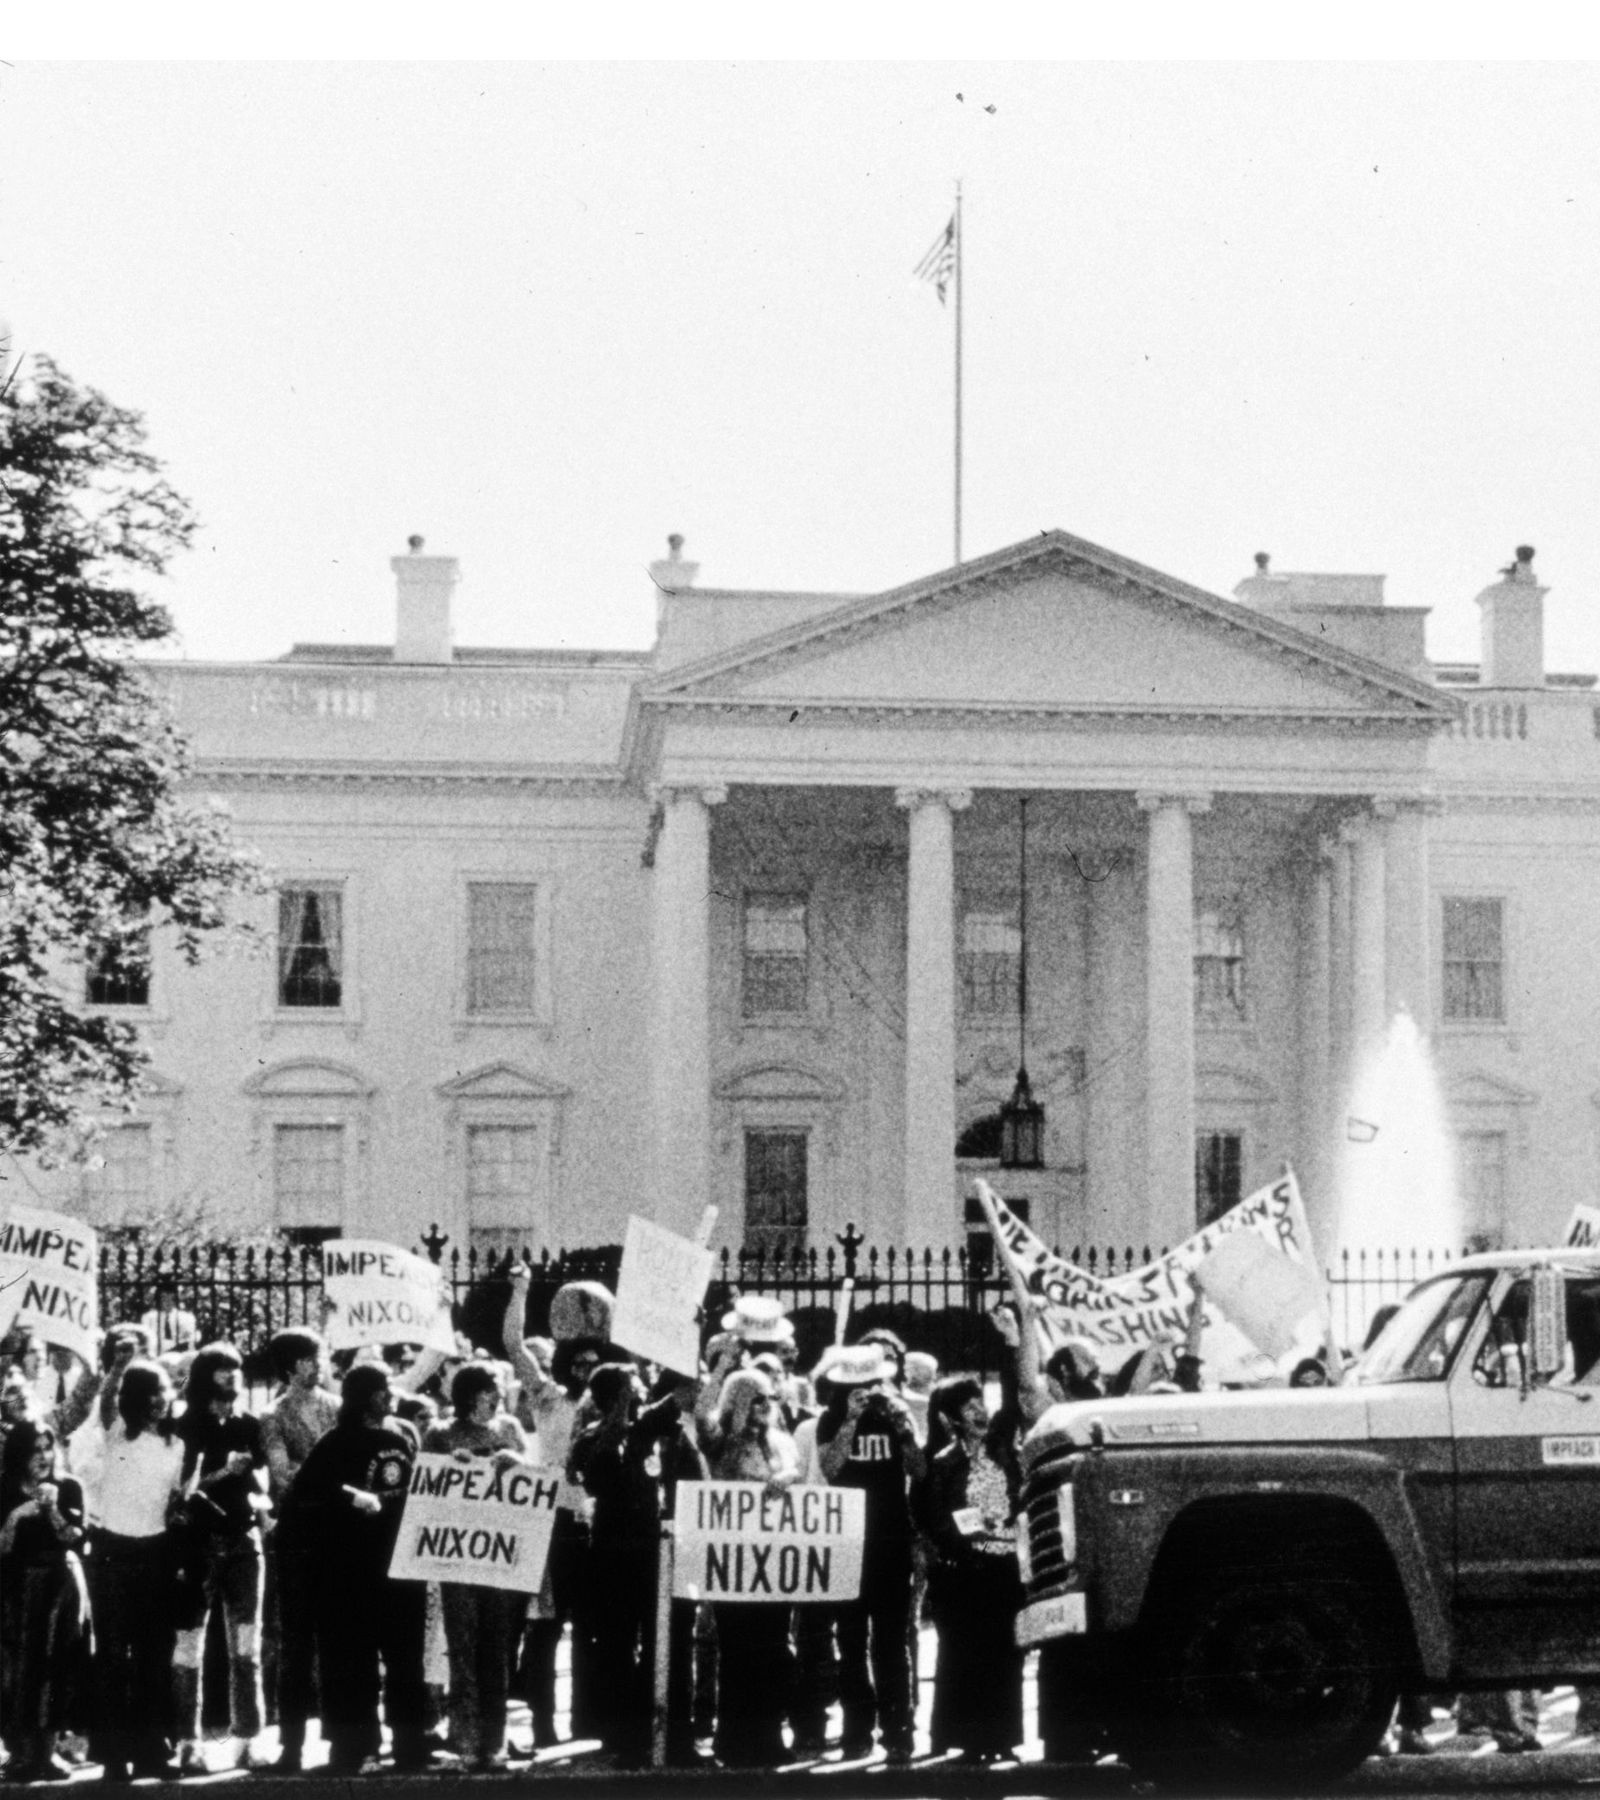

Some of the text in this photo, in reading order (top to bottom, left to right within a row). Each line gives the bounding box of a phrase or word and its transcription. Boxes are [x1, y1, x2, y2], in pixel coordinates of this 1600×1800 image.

[3, 1223, 91, 1273] IMPE
[326, 1250, 405, 1279] IMPE
[347, 1299, 433, 1328] NIXO
[410, 1465, 559, 1510] IMPEACH
[697, 1488, 842, 1535] IMPEACH
[415, 1526, 517, 1565] NIXON
[705, 1542, 831, 1593] NIXON
